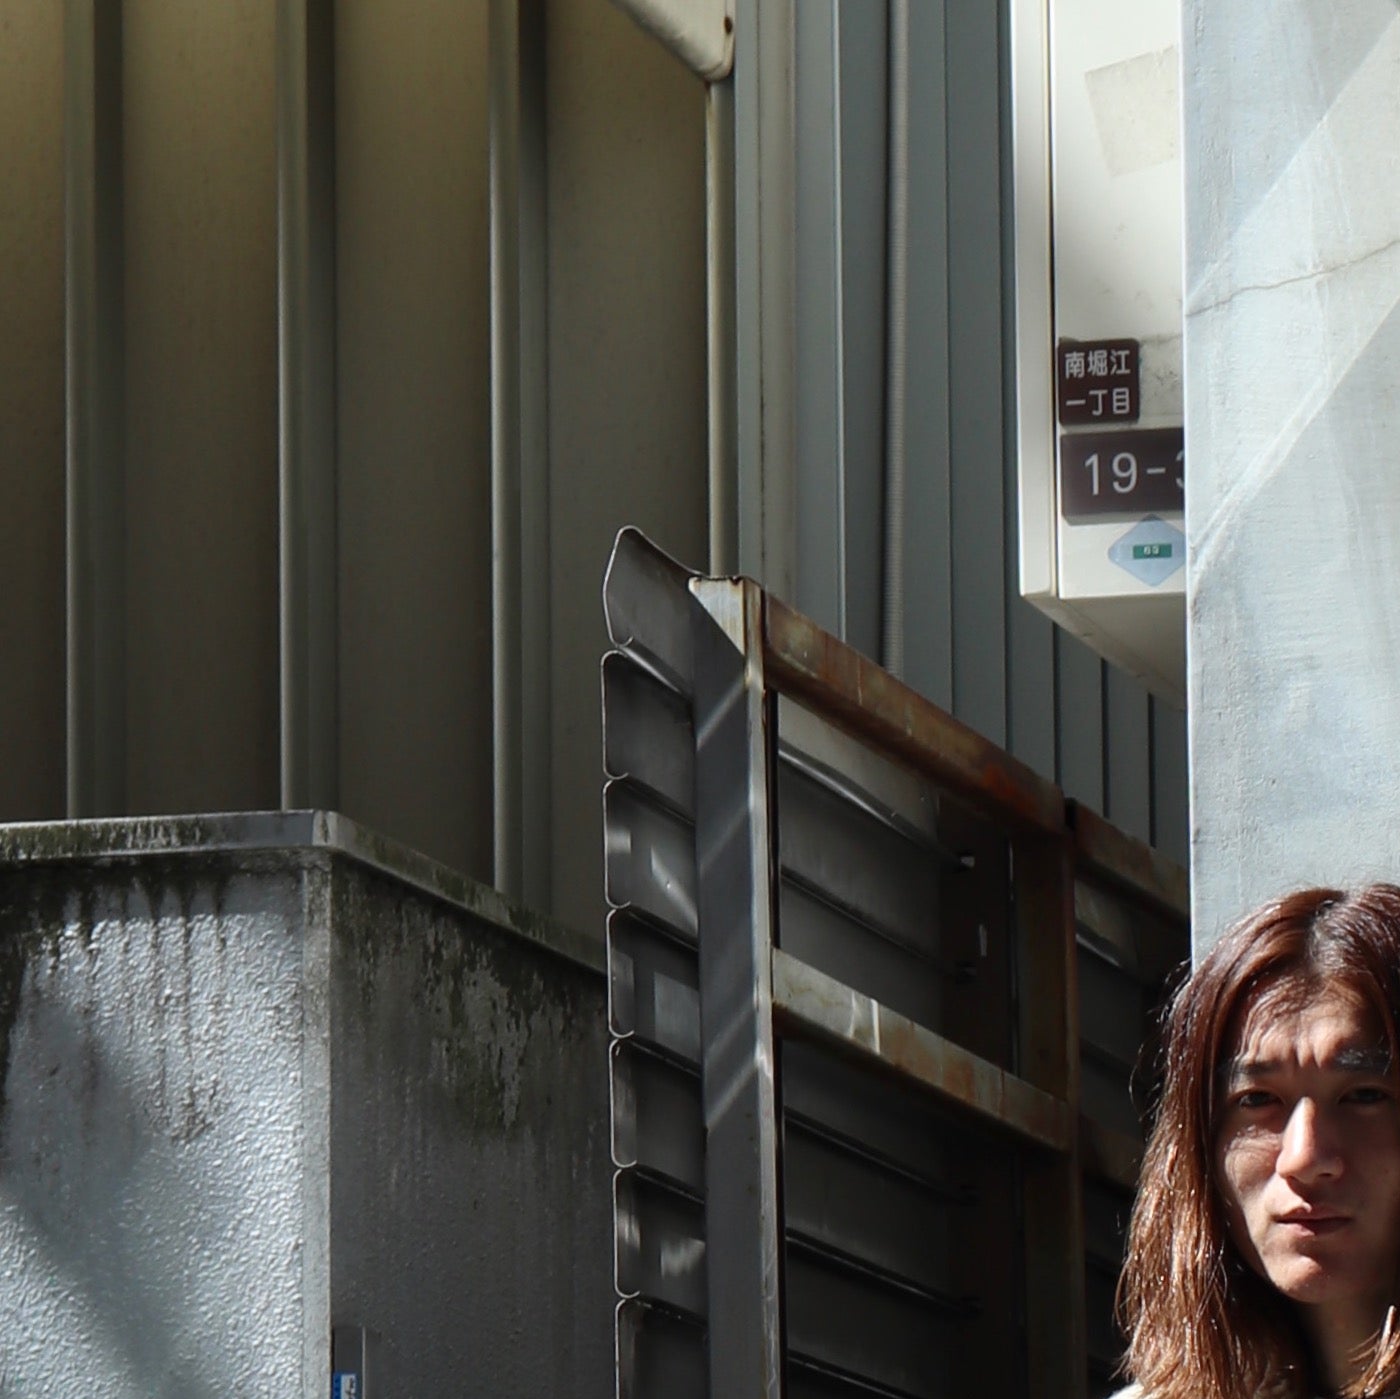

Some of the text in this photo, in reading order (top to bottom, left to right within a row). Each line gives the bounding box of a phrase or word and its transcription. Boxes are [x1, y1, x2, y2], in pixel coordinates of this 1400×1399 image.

[1064, 349, 1131, 378] 南堀江
[1065, 387, 1130, 416] 一丁目
